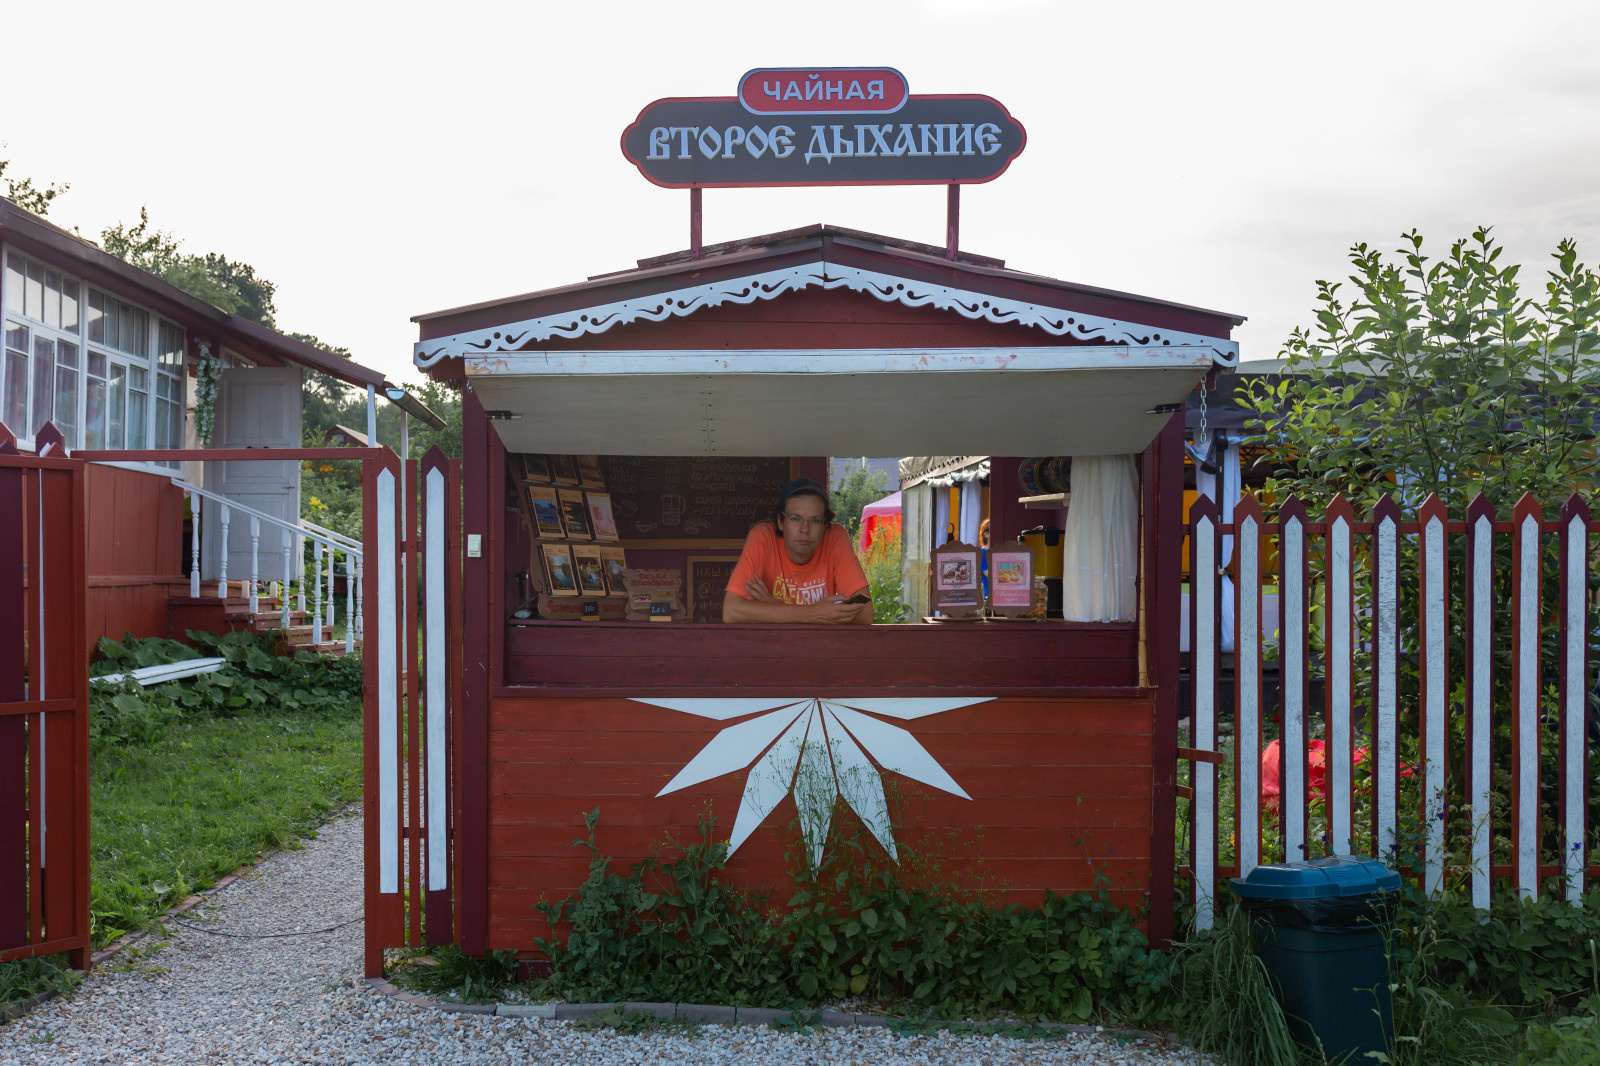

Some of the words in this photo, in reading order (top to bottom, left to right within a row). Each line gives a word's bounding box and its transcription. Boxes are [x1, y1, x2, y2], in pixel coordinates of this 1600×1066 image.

[764, 73, 884, 101] ЧАЙНАЯ
[646, 125, 796, 160] ВТОРОЕ
[804, 122, 1002, 165] ДЫХАНИЕ
